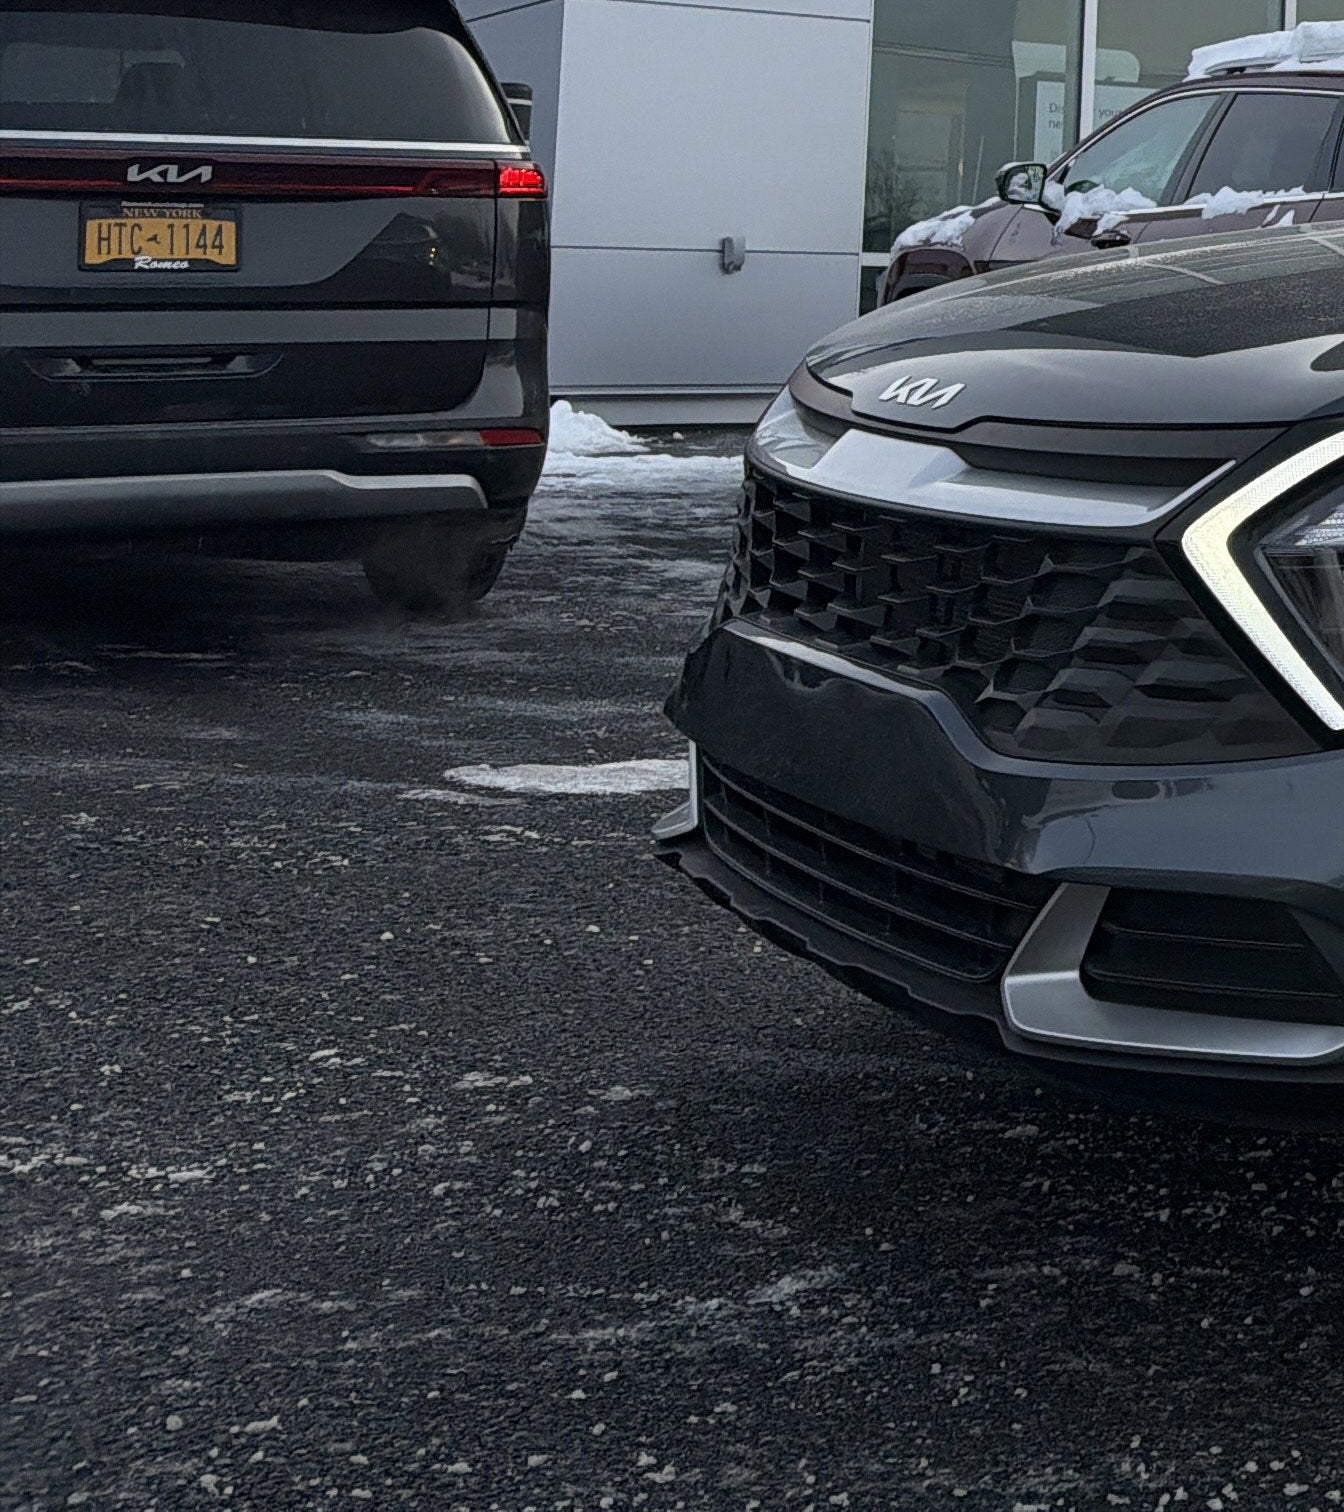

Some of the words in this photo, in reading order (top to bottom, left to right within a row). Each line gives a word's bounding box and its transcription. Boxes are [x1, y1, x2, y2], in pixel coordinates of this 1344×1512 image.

[127, 164, 213, 184] KIA
[122, 209, 158, 218] NEW
[163, 209, 202, 218] YORK
[133, 256, 190, 270] Romeo
[878, 375, 967, 410] KIA
